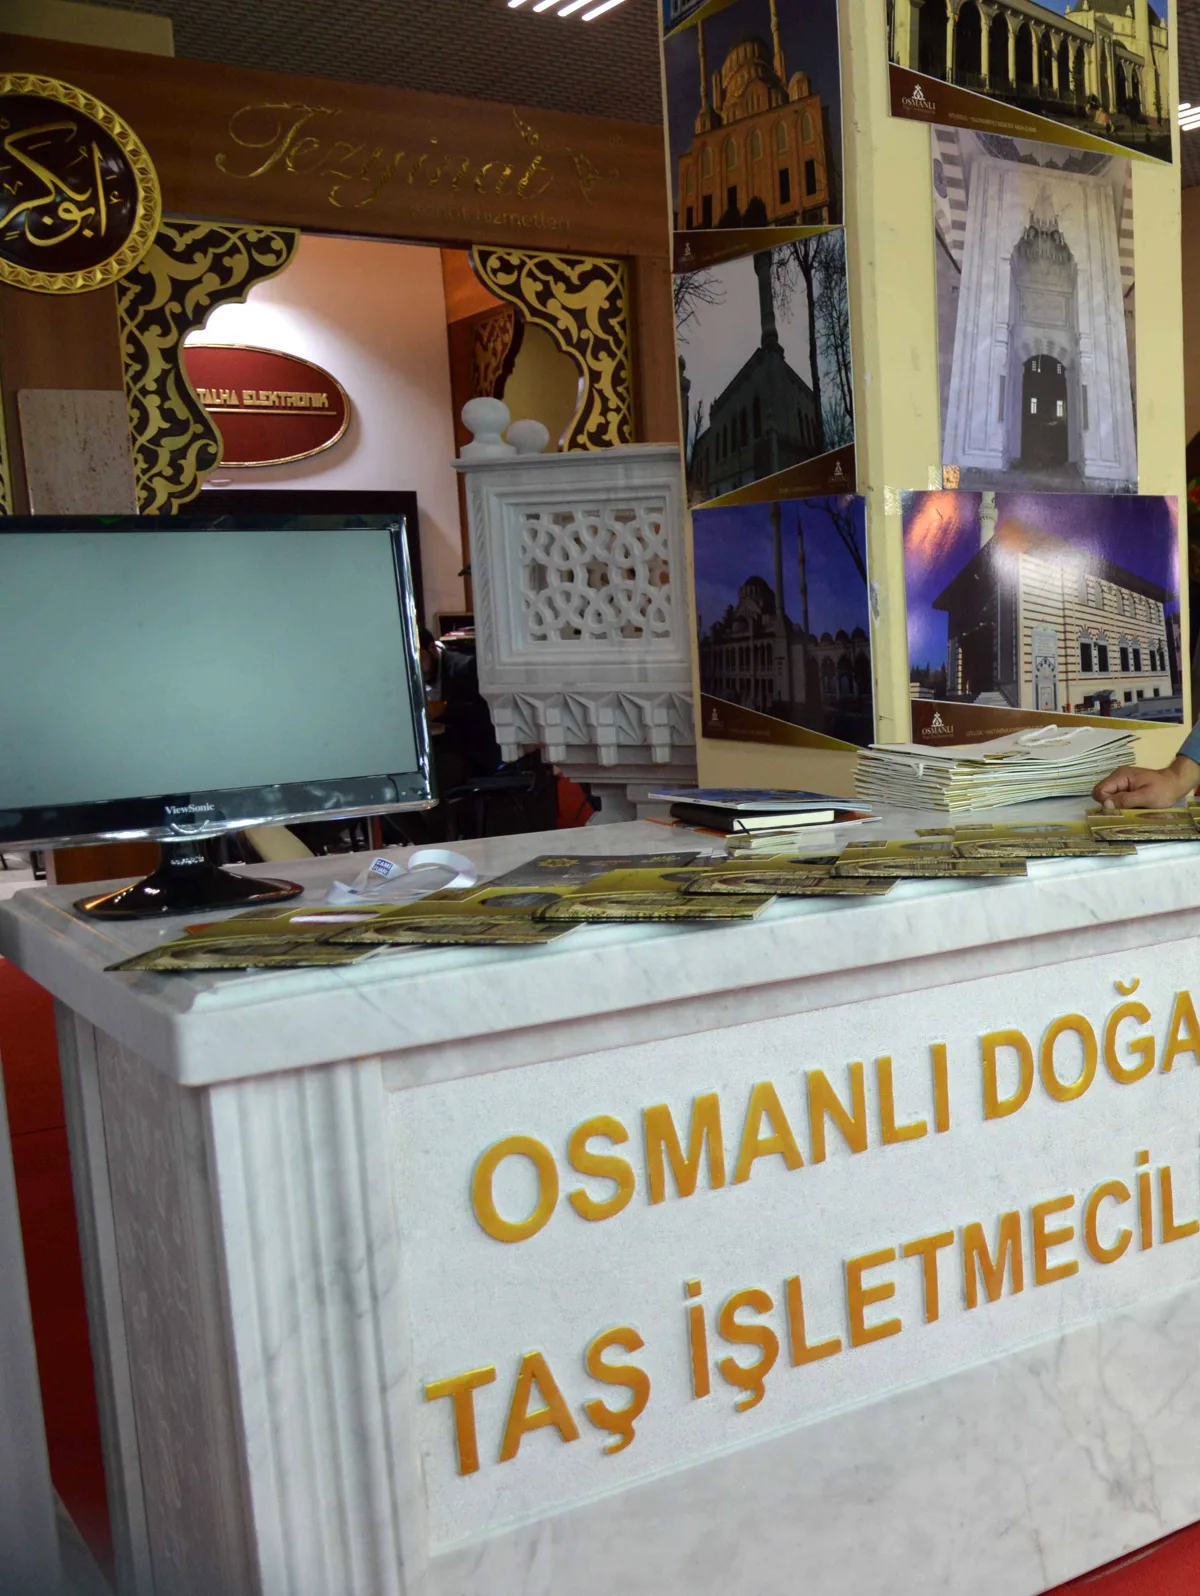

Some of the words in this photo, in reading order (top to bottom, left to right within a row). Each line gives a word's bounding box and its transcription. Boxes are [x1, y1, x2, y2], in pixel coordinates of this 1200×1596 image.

[901, 97, 936, 110] OSMANLI
[196, 388, 239, 406] TALHA
[921, 725, 954, 736] OSMANLI
[164, 803, 215, 815] ViewSonic
[472, 1042, 951, 1244] OSMANLI
[425, 1325, 653, 1477] TAŞ
